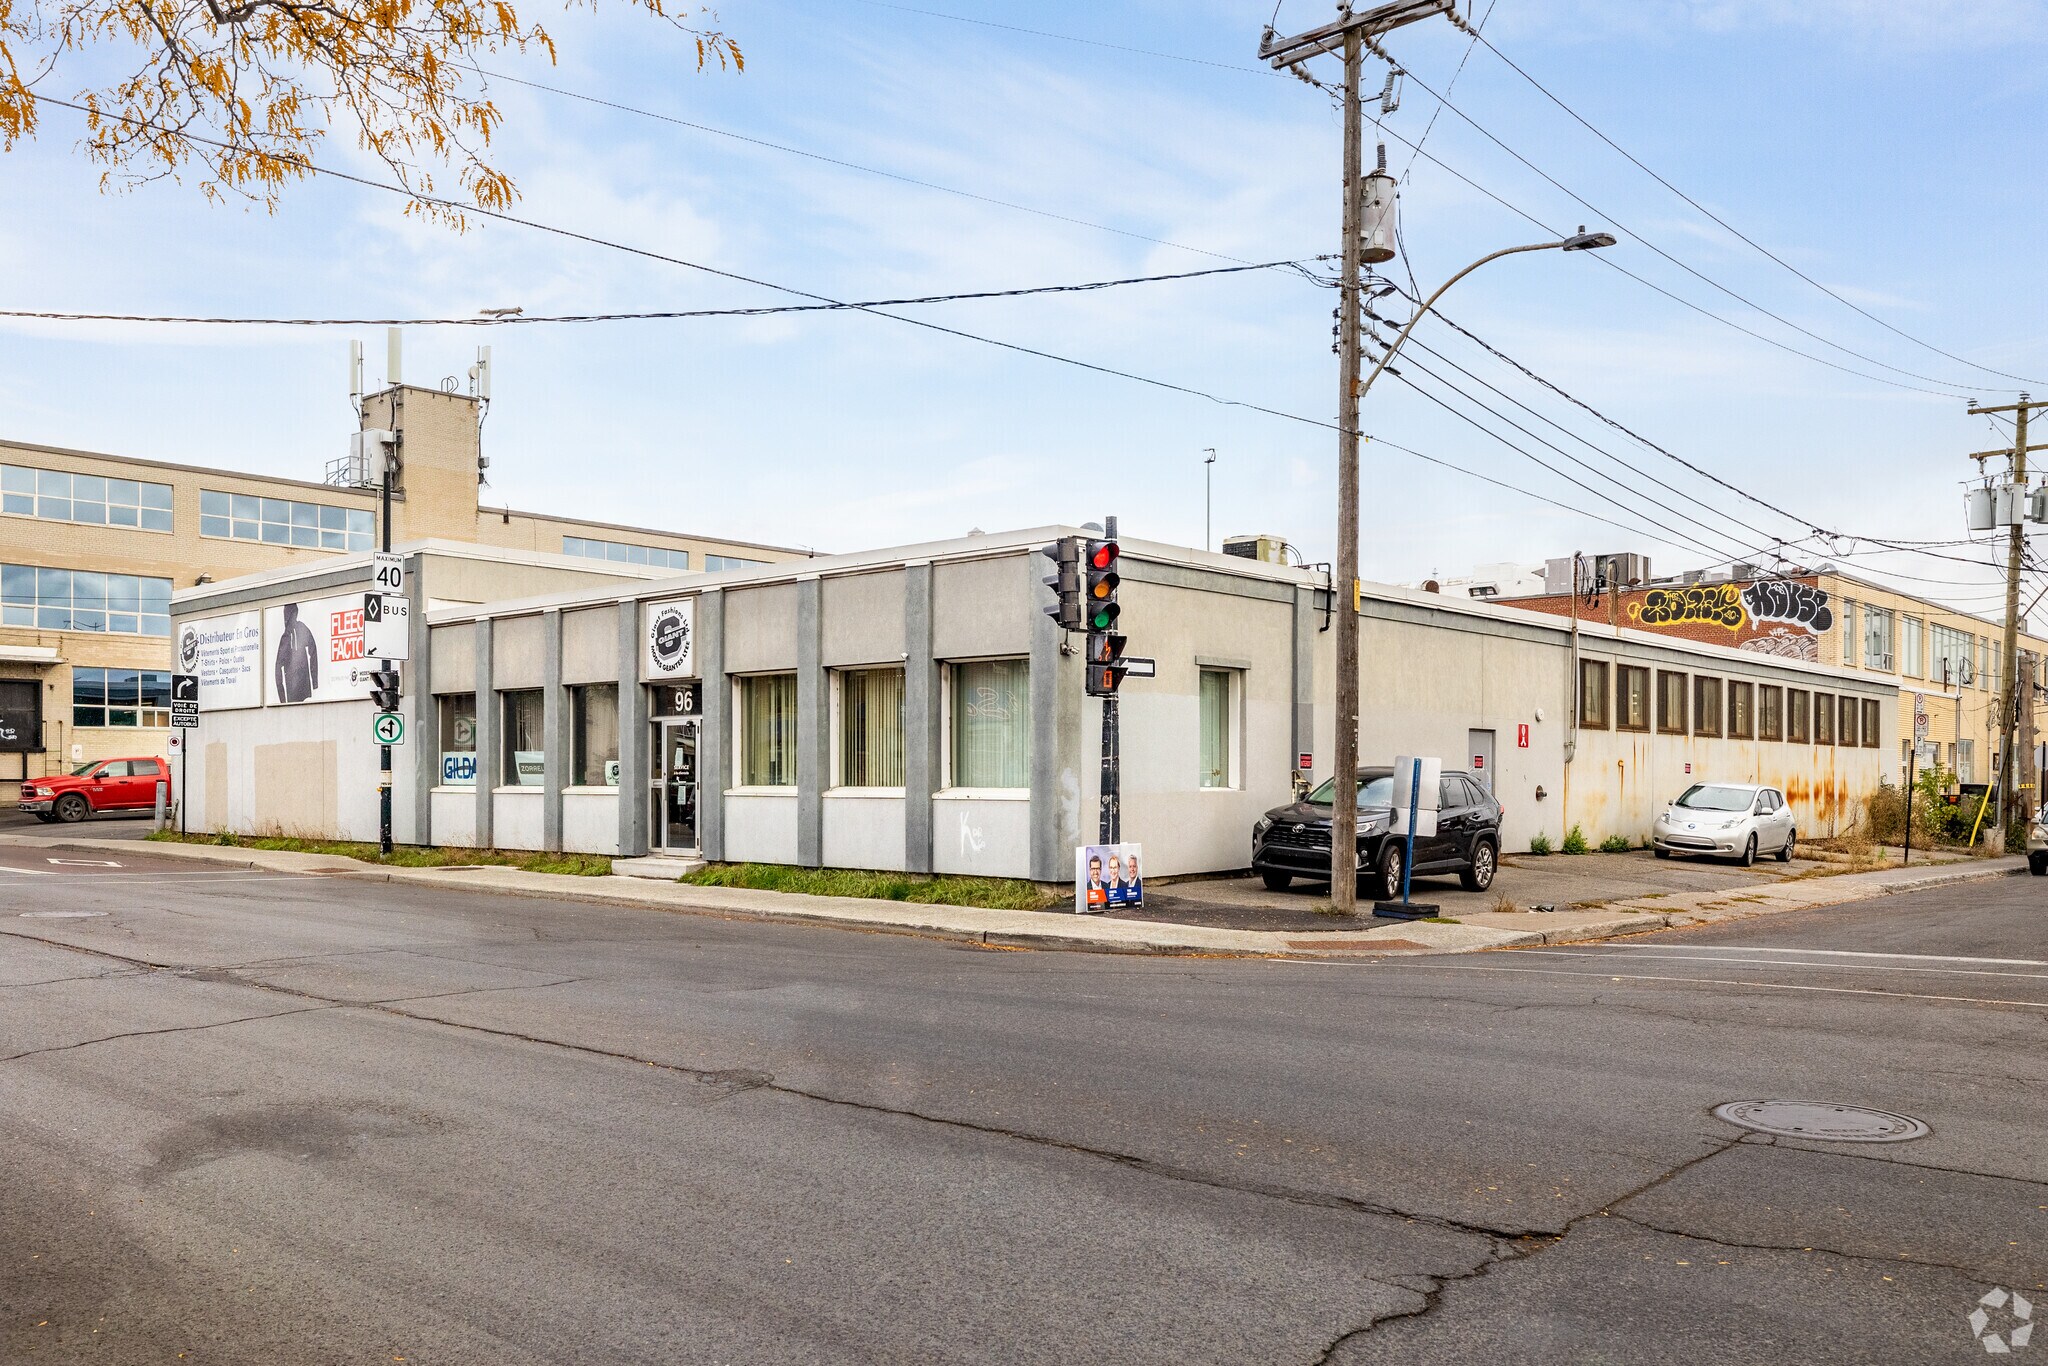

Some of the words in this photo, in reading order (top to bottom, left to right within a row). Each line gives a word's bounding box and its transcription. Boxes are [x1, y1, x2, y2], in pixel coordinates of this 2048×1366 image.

[376, 566, 402, 588] 40
[383, 605, 408, 616] BUS
[331, 610, 364, 635] FLEEC
[651, 615, 661, 639] Giant
[661, 607, 684, 619] Fashions
[200, 631, 235, 645] Distributeur
[244, 626, 259, 638] Gros
[658, 629, 685, 645] GIANT
[331, 636, 364, 660] FACTO
[651, 645, 662, 668] MODES
[675, 690, 693, 711] 96
[444, 757, 477, 779] GILDA
